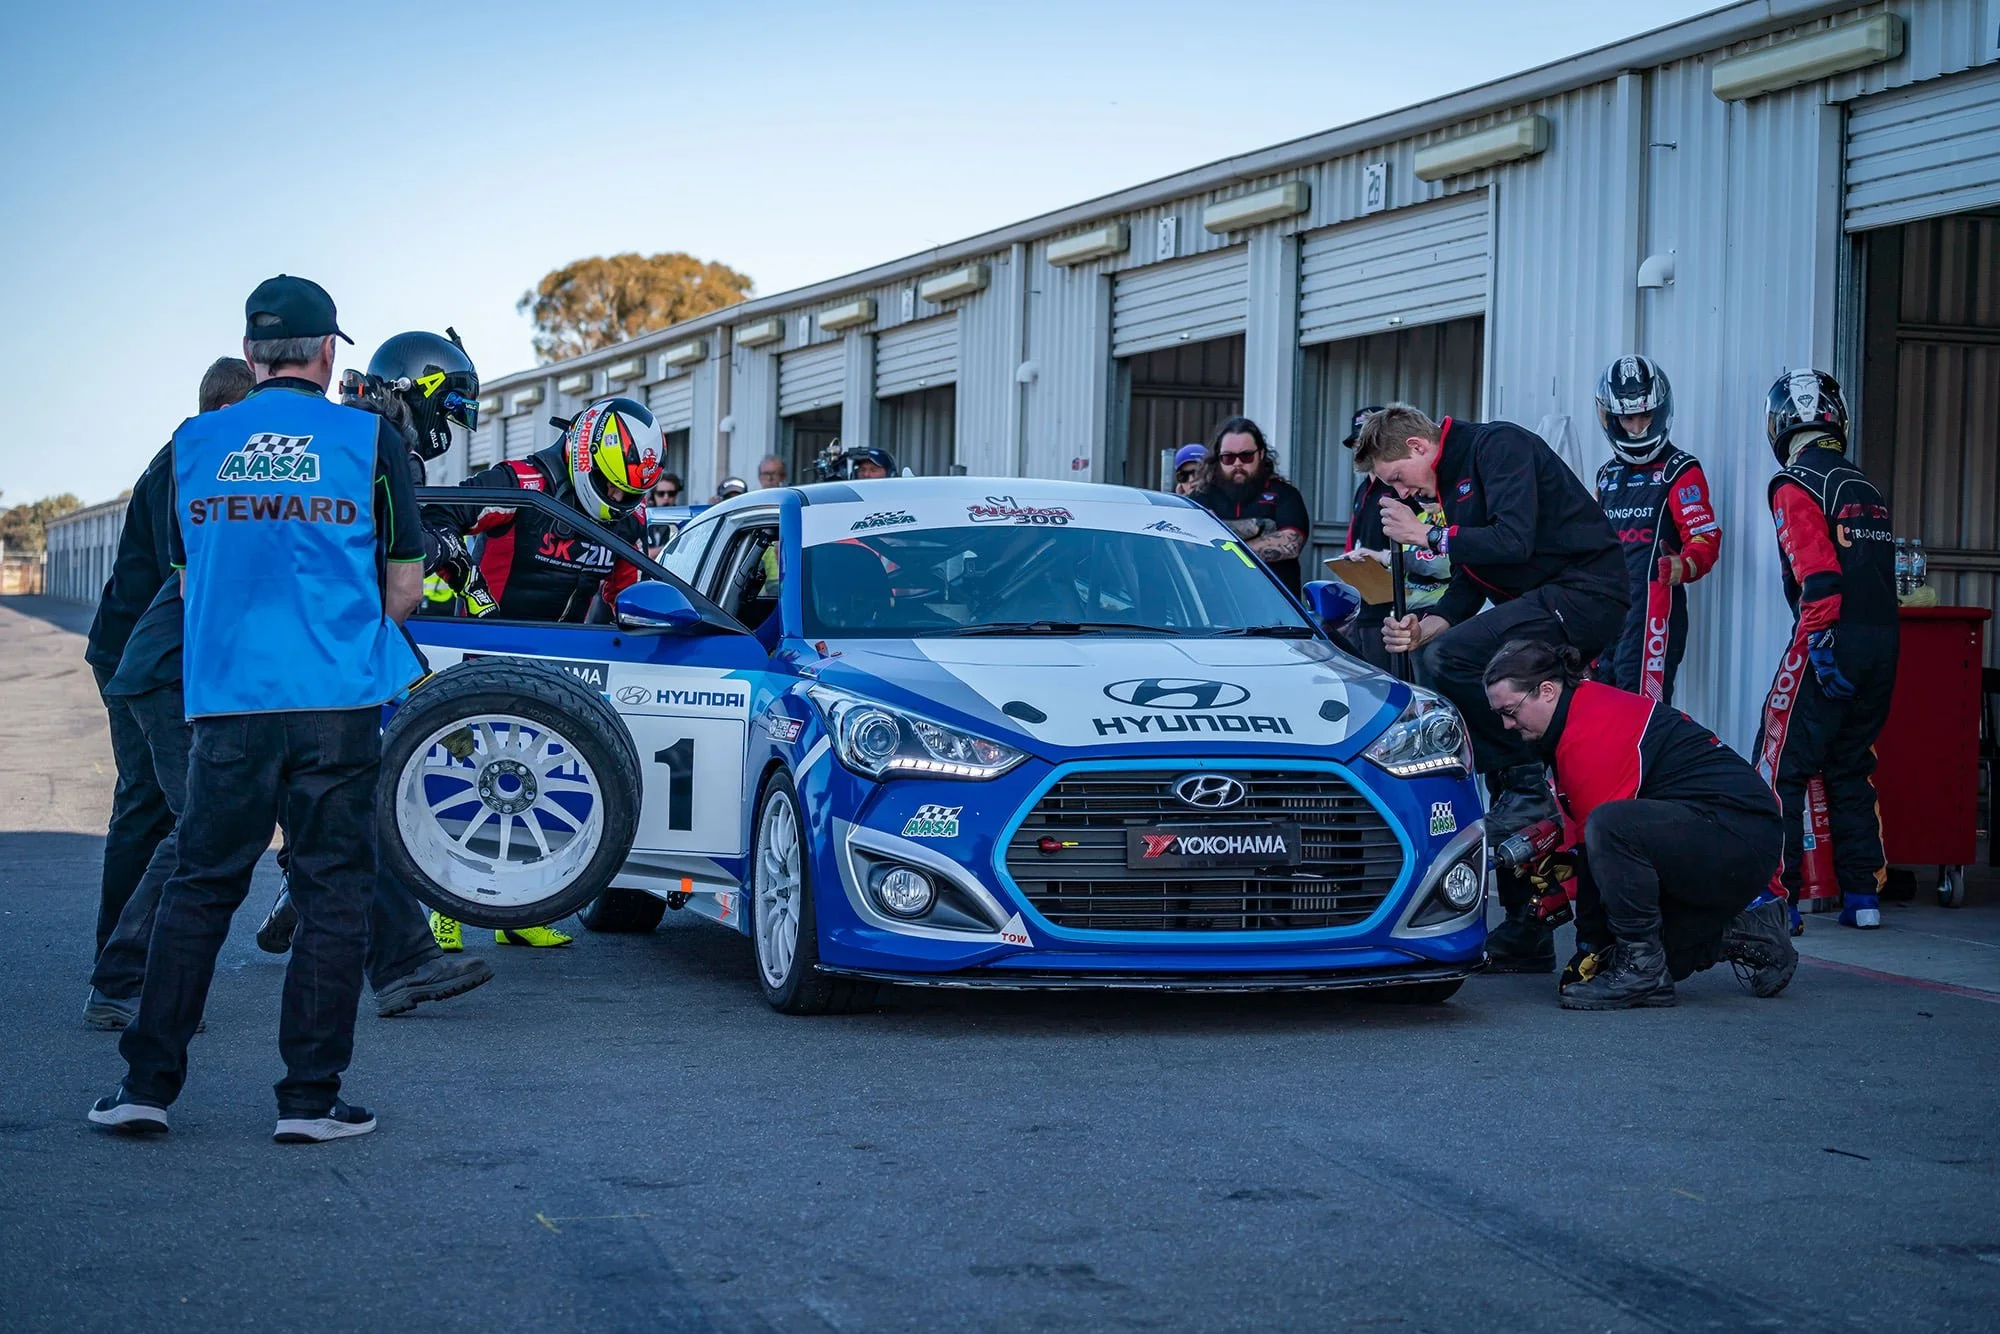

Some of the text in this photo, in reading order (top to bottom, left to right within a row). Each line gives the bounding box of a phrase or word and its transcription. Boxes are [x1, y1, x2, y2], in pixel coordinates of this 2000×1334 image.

[429, 428, 439, 448] VALO
[578, 421, 593, 472] PEDDERS
[218, 454, 318, 481] AASA
[189, 495, 357, 526] STEWARD
[967, 505, 1075, 520] Winton
[1014, 514, 1069, 525] 300
[851, 515, 916, 530] AASA
[538, 532, 575, 561] SK
[1221, 541, 1256, 568] 1
[1647, 617, 1667, 671] BOC
[1771, 652, 1802, 710] BOC
[657, 690, 745, 707] HYUNDAI
[1092, 715, 1294, 736] HYUNDAI
[655, 738, 694, 831] 1
[904, 819, 957, 835] AASA
[1431, 816, 1456, 833] AASA
[1177, 835, 1287, 855] YOKOHAMA
[1001, 932, 1027, 944] TOW
